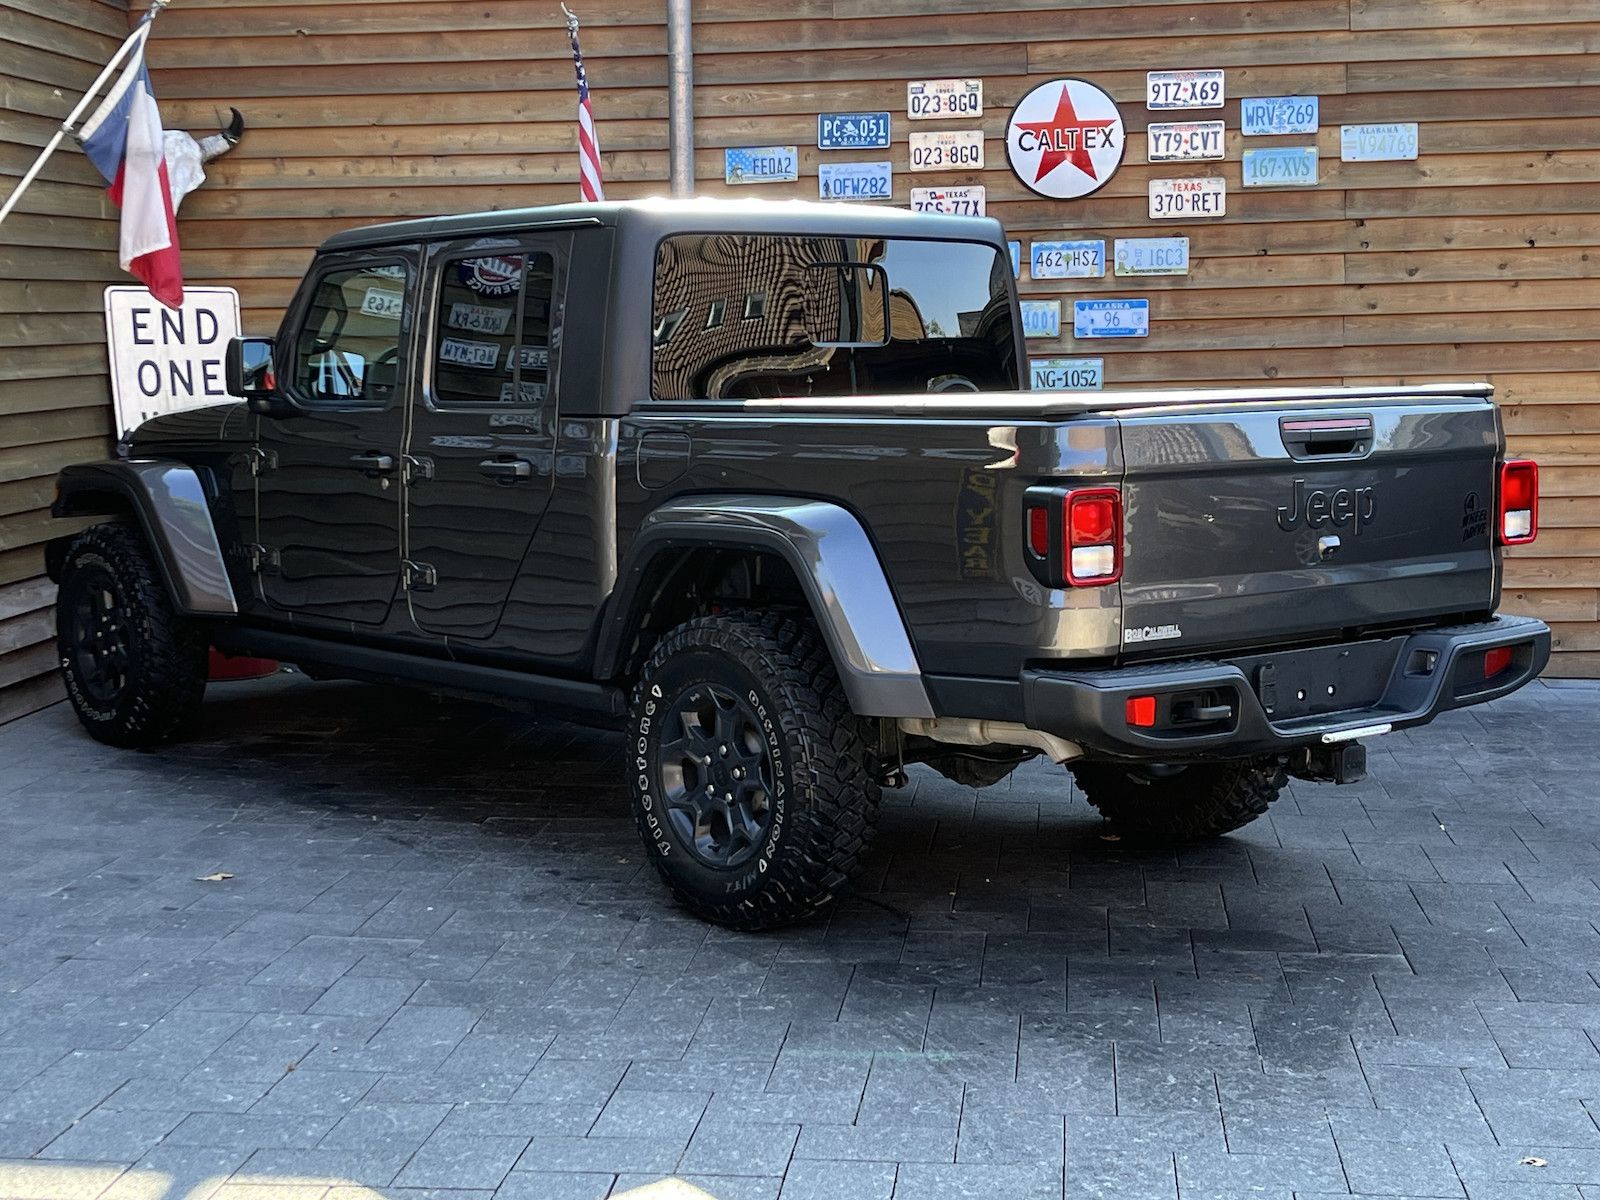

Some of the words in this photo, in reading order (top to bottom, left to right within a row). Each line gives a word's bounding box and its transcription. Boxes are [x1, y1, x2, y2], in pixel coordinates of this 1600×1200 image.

[1152, 83, 1181, 101] 9TZ
[1190, 81, 1219, 100] X69
[912, 95, 941, 113] 023
[948, 93, 978, 112] 8GQ
[1245, 105, 1275, 126] WRV
[1287, 104, 1314, 125] 269
[823, 119, 841, 137] PC
[859, 119, 886, 137] 051
[1359, 126, 1398, 135] ALABAMA
[1018, 127, 1115, 152] CALTEX
[1153, 133, 1183, 152] Y79
[1190, 131, 1220, 150] CVT
[913, 147, 942, 165] 023
[950, 145, 979, 164] 8GQ
[1172, 183, 1203, 191] TEXAS
[952, 200, 980, 217] 77X
[1154, 194, 1183, 212] 370
[1192, 192, 1221, 212] RET
[1036, 252, 1062, 267] 462
[1073, 250, 1099, 266] HSZ
[131, 308, 219, 345] END
[1104, 311, 1120, 327] 96
[138, 359, 225, 397] ONE
[1036, 369, 1097, 387] NG-1052
[1276, 478, 1377, 536] Jeep
